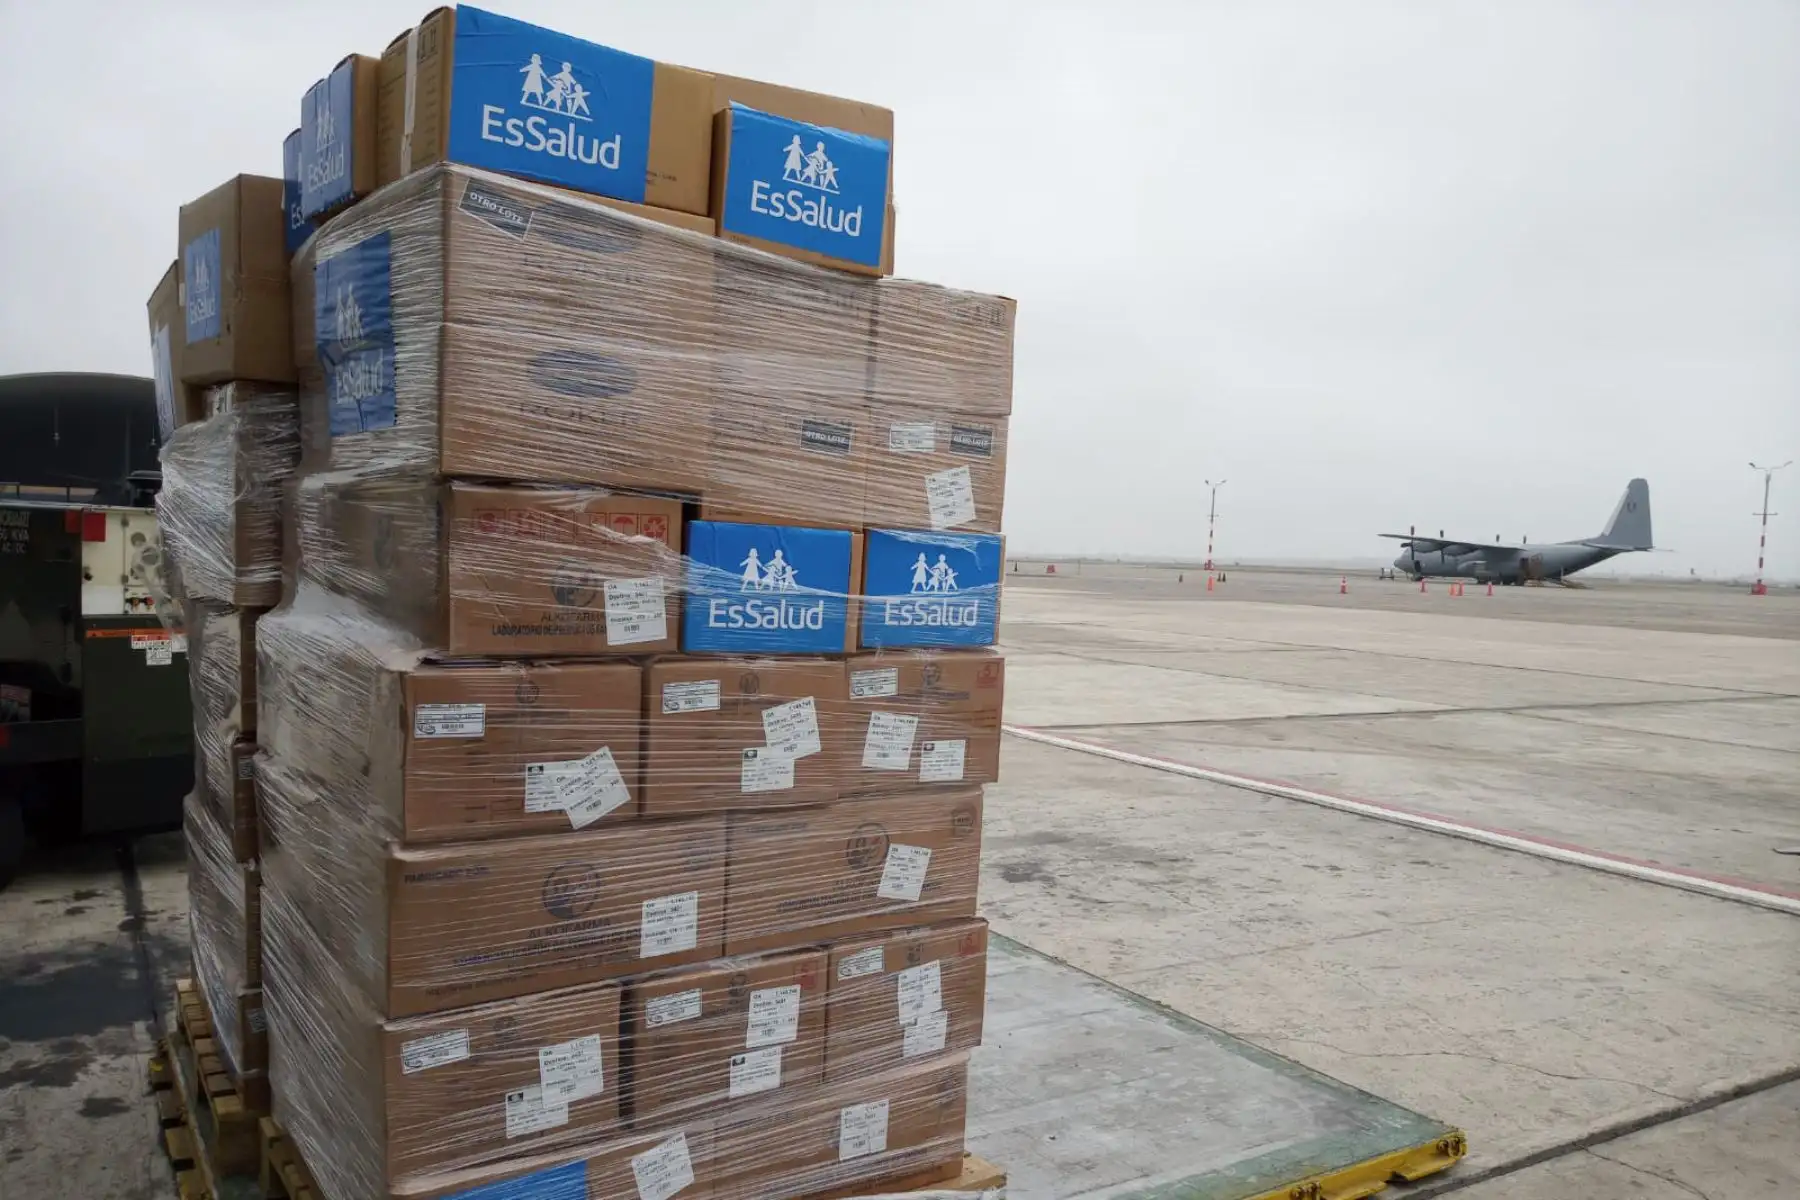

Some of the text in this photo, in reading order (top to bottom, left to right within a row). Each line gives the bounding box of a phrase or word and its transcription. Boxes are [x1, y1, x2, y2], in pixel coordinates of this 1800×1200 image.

[482, 105, 621, 170] EsSalud
[307, 143, 344, 194] EsSalud
[470, 191, 497, 211] OTRO
[751, 181, 862, 237] EsSalud
[709, 598, 824, 630] EsSalud
[884, 600, 979, 627] EsSalud
